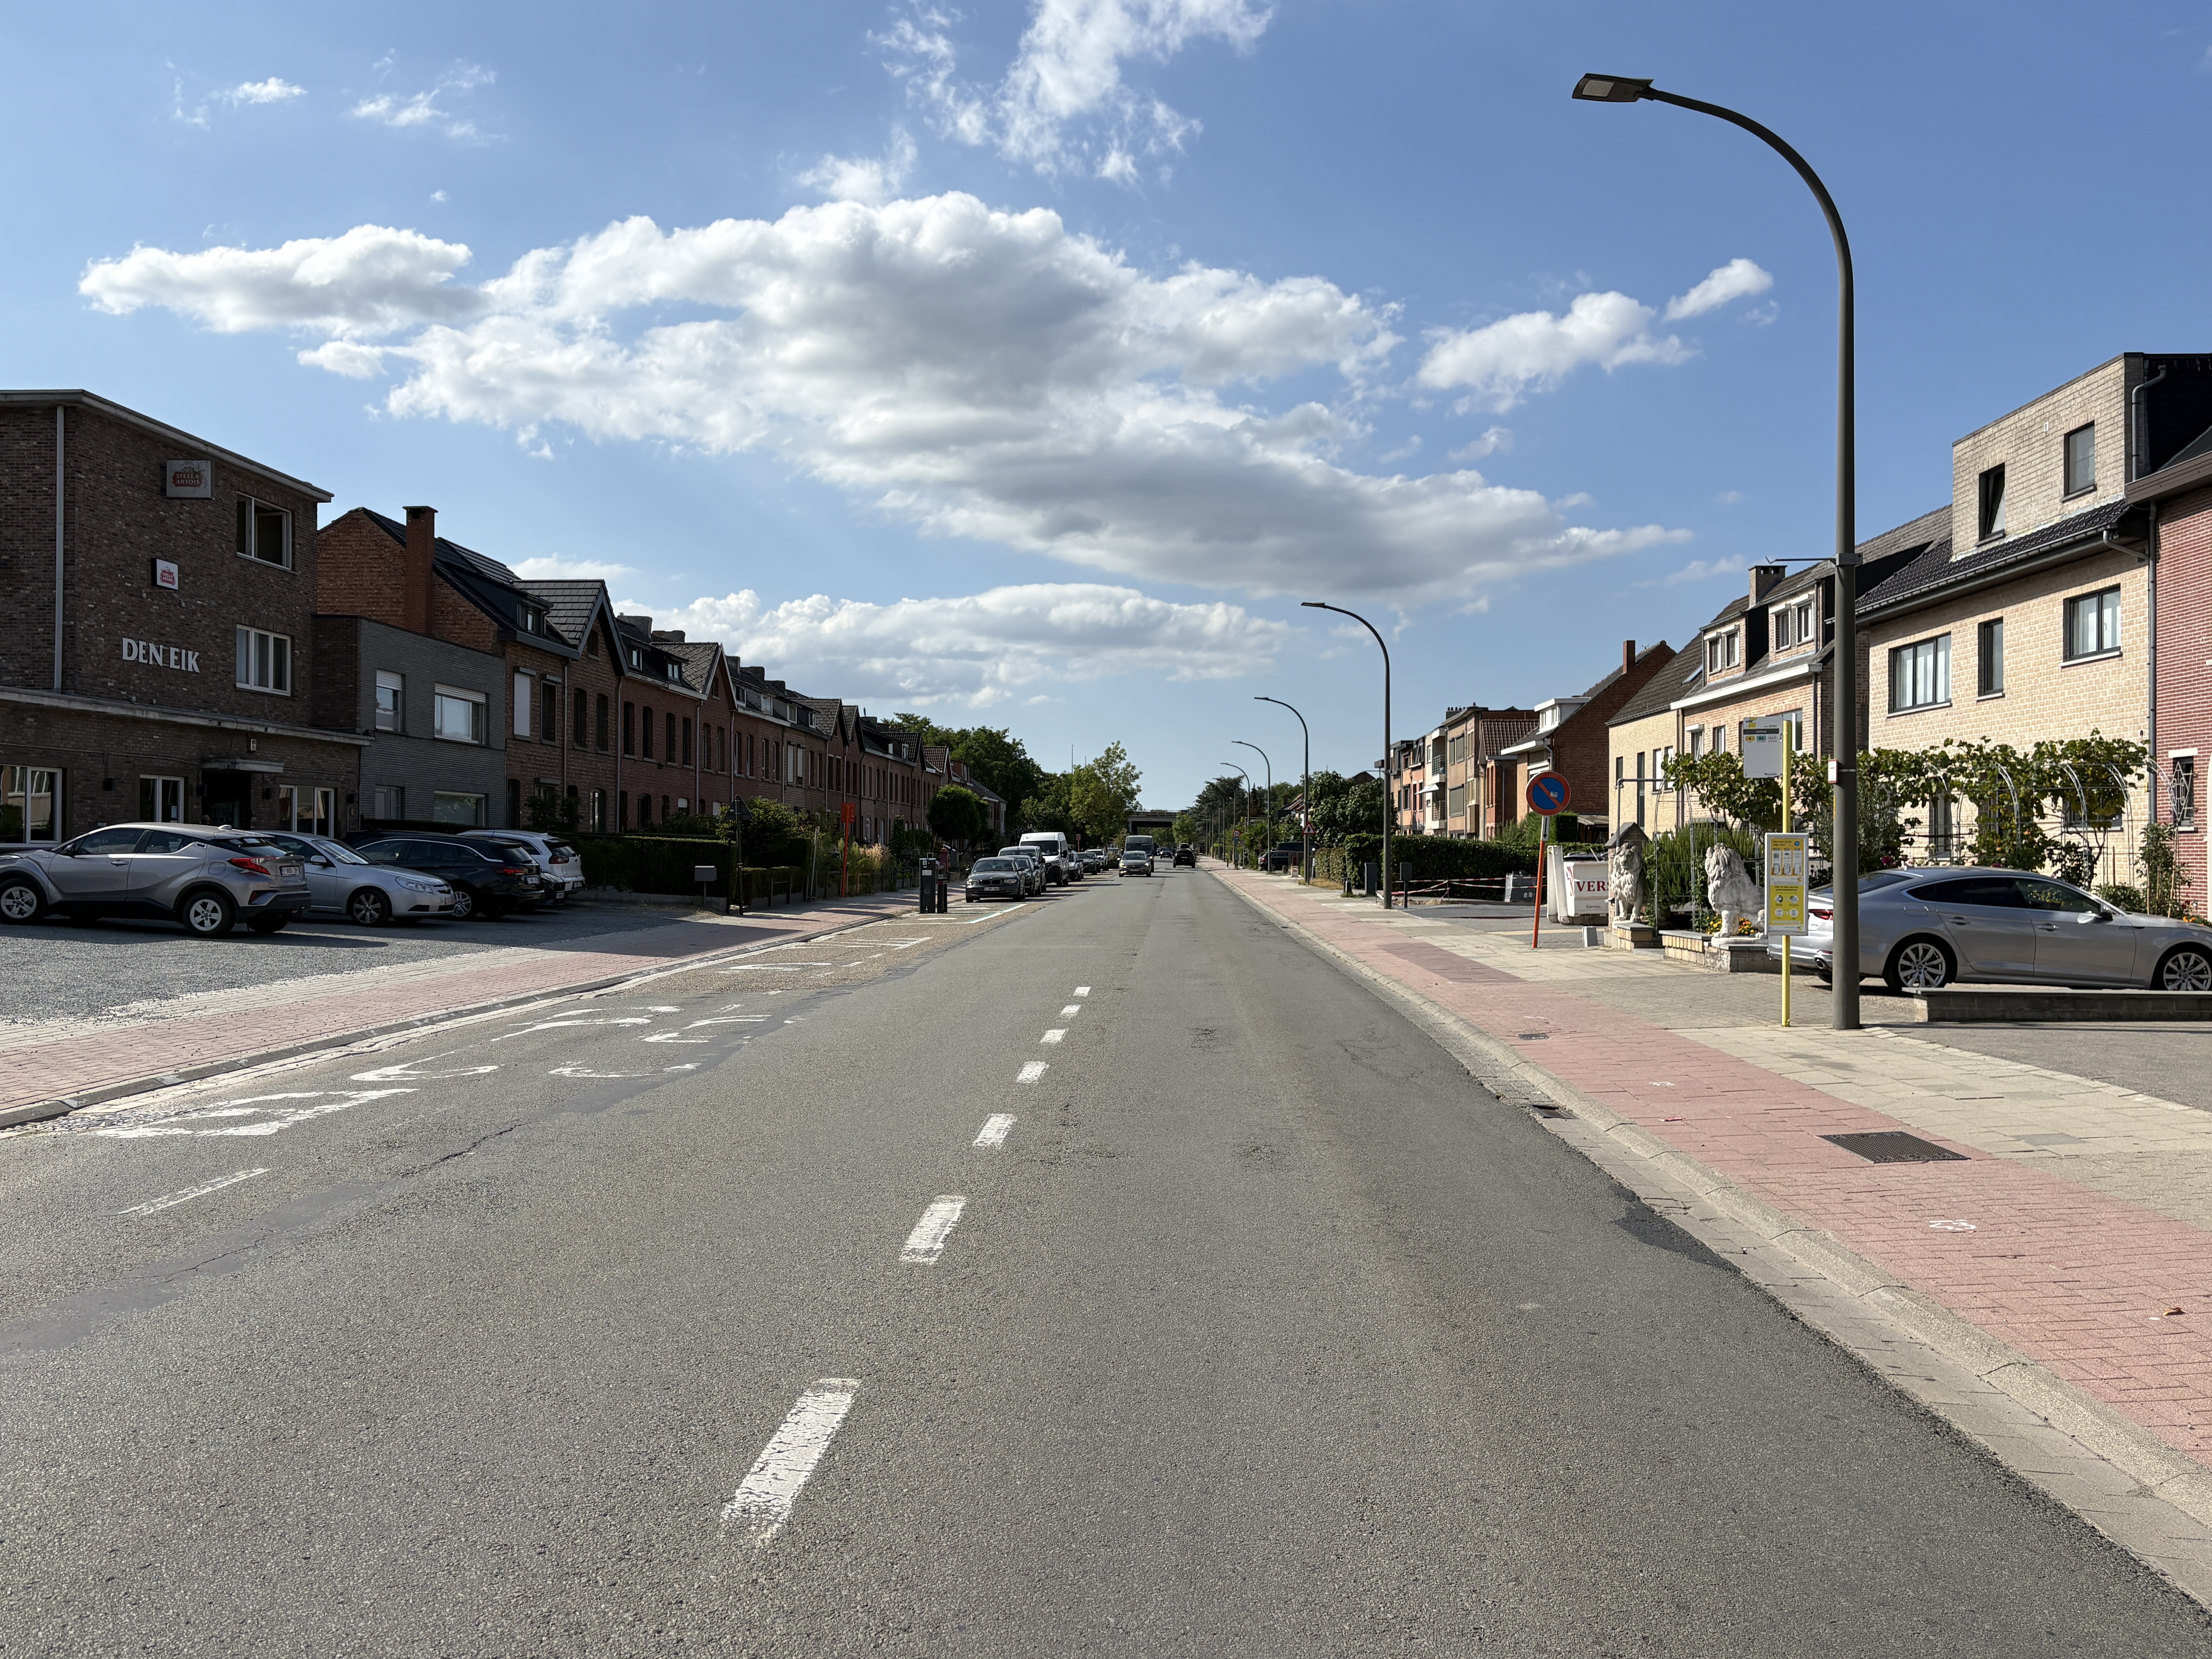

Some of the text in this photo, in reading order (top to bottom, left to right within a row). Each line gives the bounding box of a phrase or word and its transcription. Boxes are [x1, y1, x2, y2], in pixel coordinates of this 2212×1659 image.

[122, 637, 200, 673] DEN EIK
[1576, 881, 1609, 892] VER
